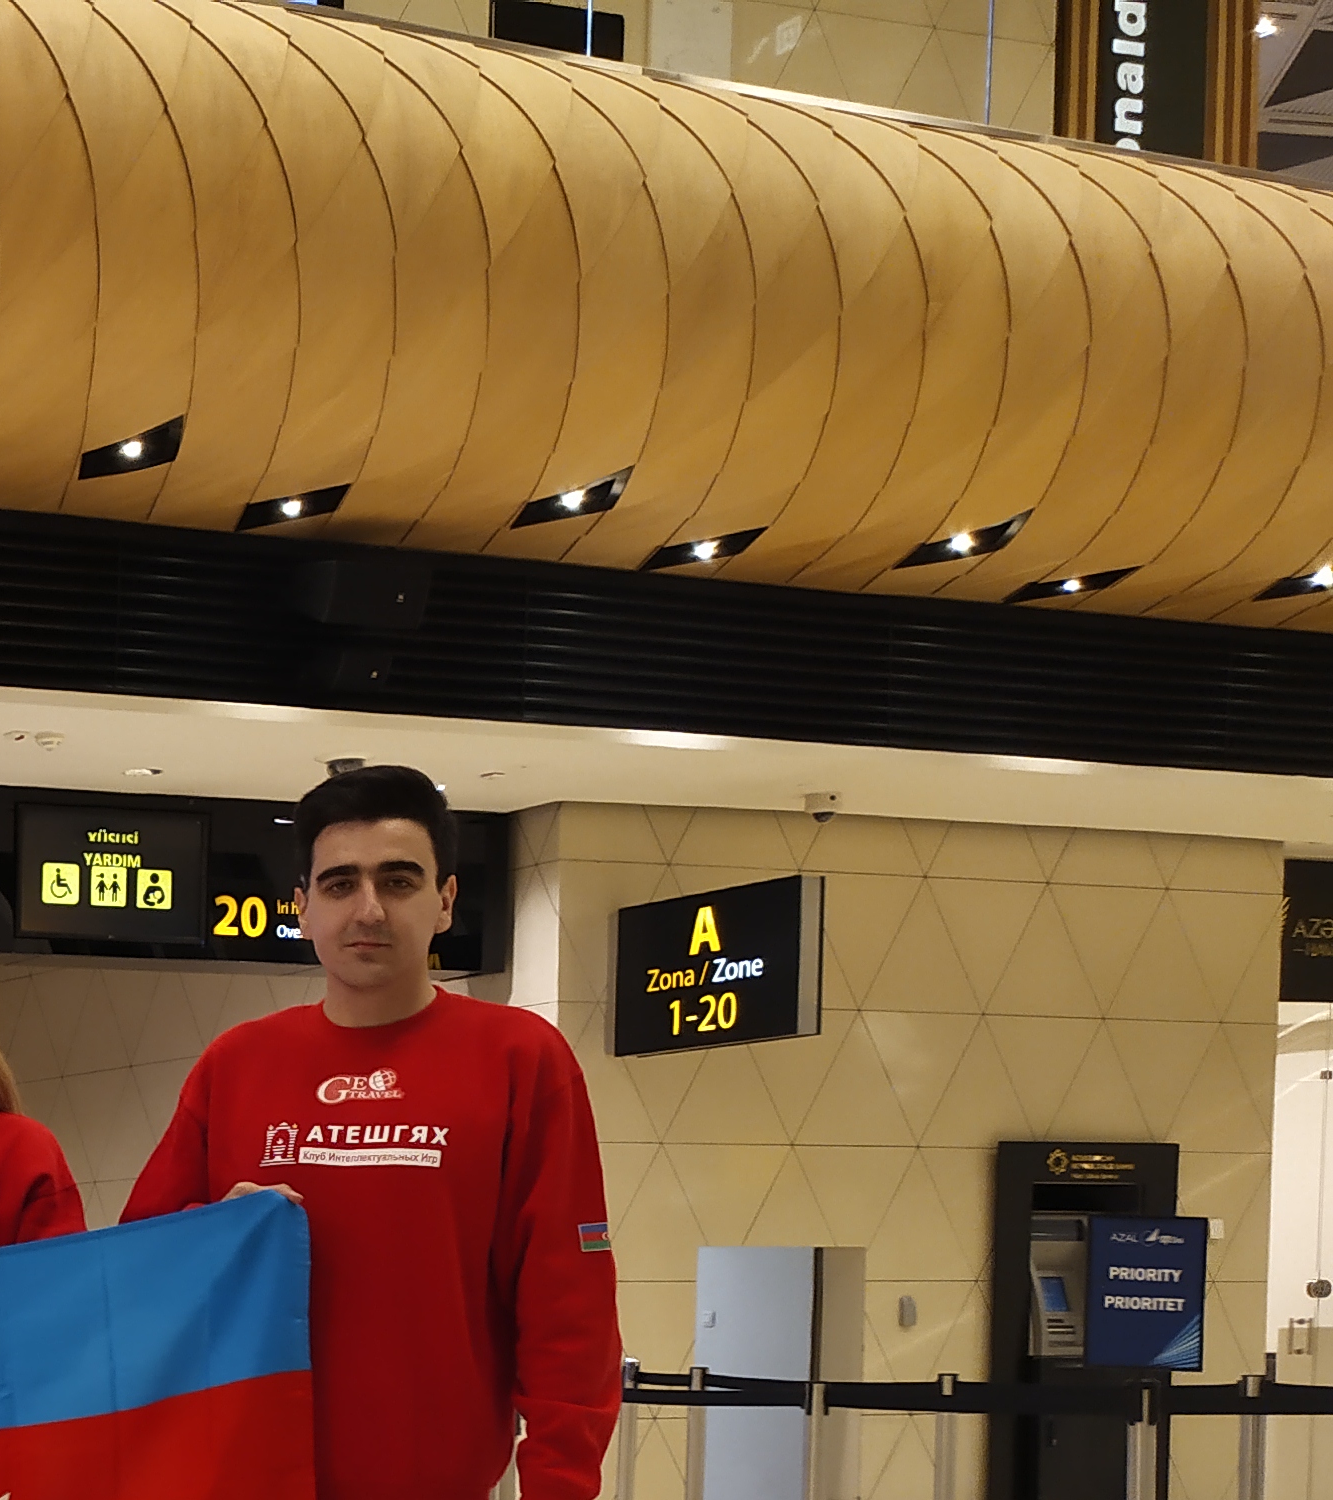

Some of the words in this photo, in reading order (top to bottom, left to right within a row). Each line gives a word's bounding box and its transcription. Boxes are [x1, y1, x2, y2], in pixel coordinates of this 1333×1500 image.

[83, 852, 142, 868] YARDIM
[213, 895, 268, 938] 20
[688, 904, 722, 956] A
[646, 968, 695, 993] Zona
[698, 960, 710, 986] /
[711, 957, 764, 983] Zone
[669, 991, 738, 1036] 1-20
[347, 1090, 402, 1100] TRAVEL
[306, 1124, 449, 1146] АТЕШГЯХ
[302, 1150, 326, 1162] Клуб
[420, 1152, 438, 1165] Игр
[1109, 1266, 1183, 1282] PRIORITY
[1104, 1295, 1186, 1312] PRIORITET
